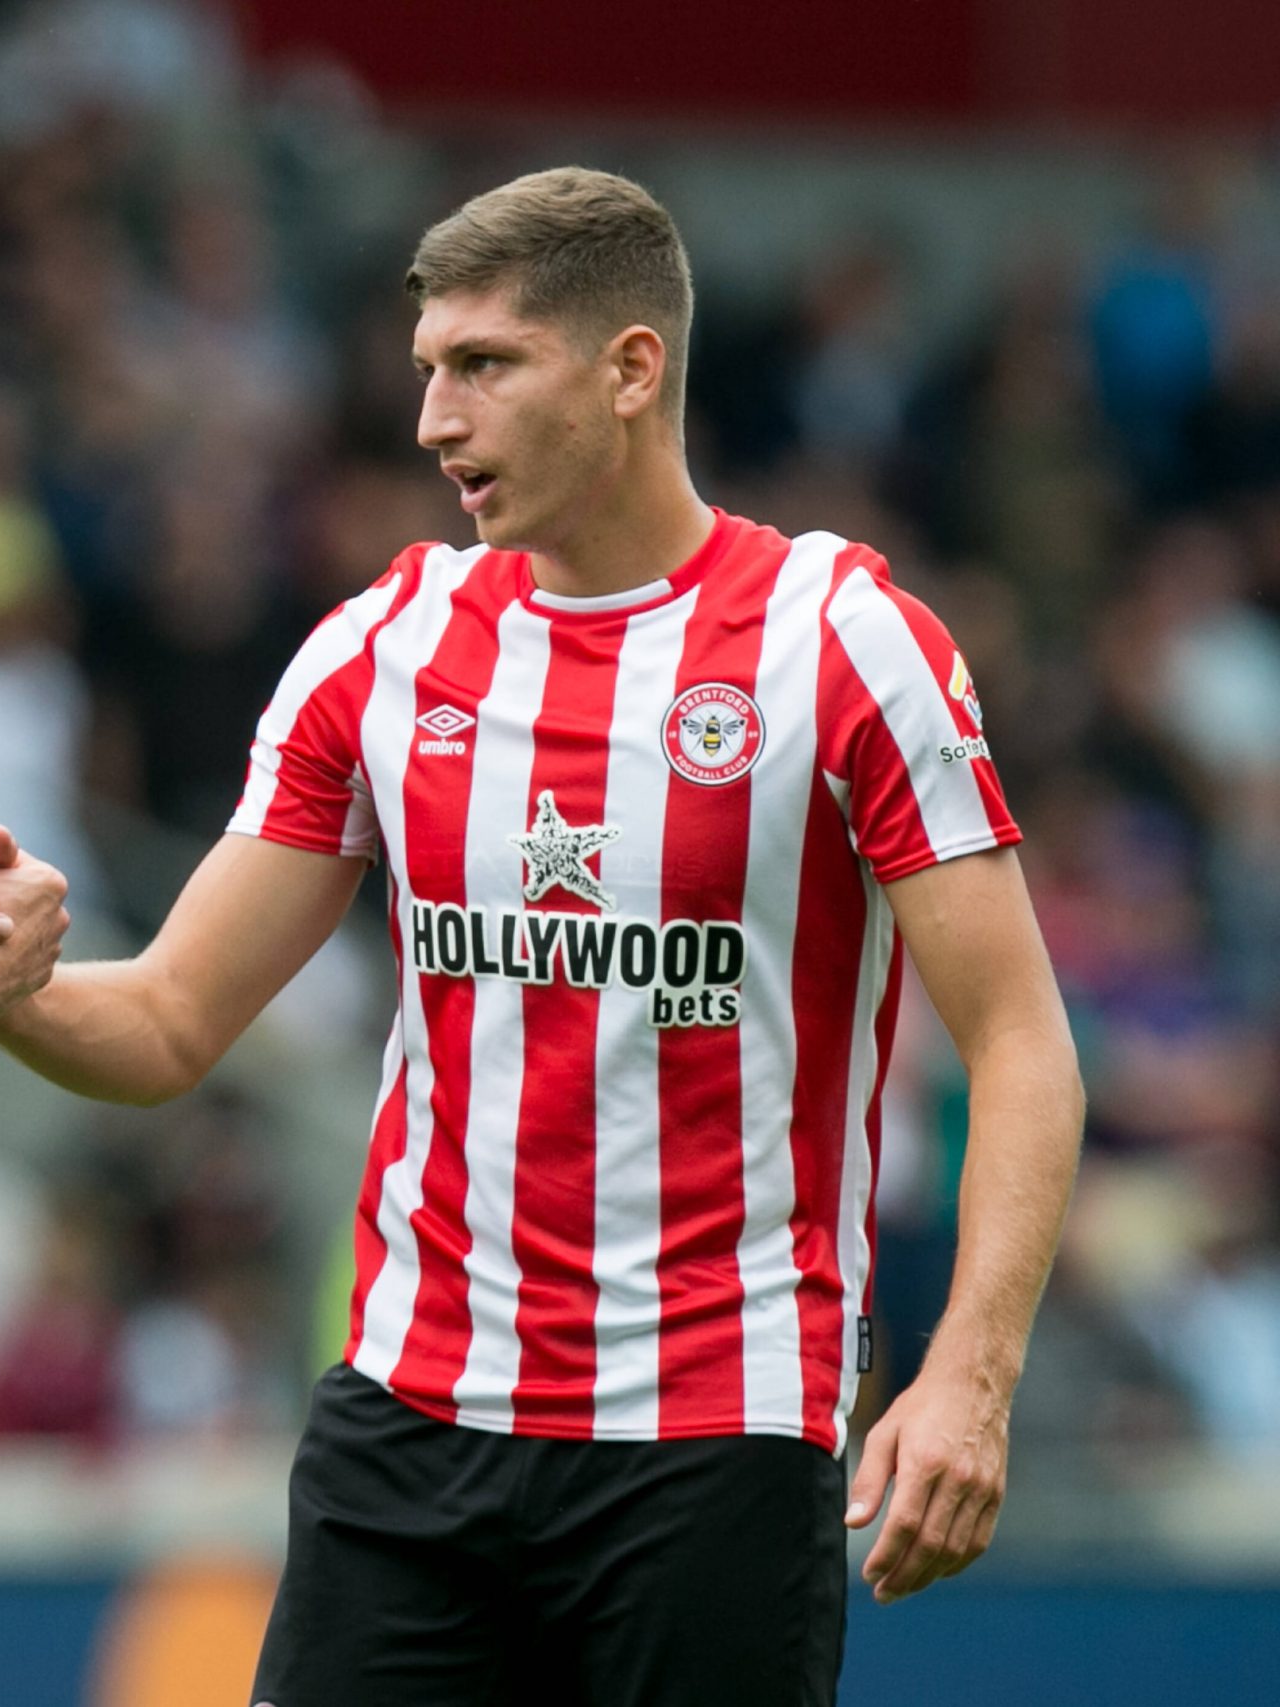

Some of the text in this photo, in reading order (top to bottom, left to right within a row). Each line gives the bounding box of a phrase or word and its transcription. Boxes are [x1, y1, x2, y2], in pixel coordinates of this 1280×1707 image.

[679, 689, 749, 714] BRENTFORD
[419, 738, 466, 756] umbro
[676, 755, 748, 779] FOOTBALL CLUB
[412, 904, 745, 988] HOLLYWOOD
[652, 988, 738, 1023] bets
